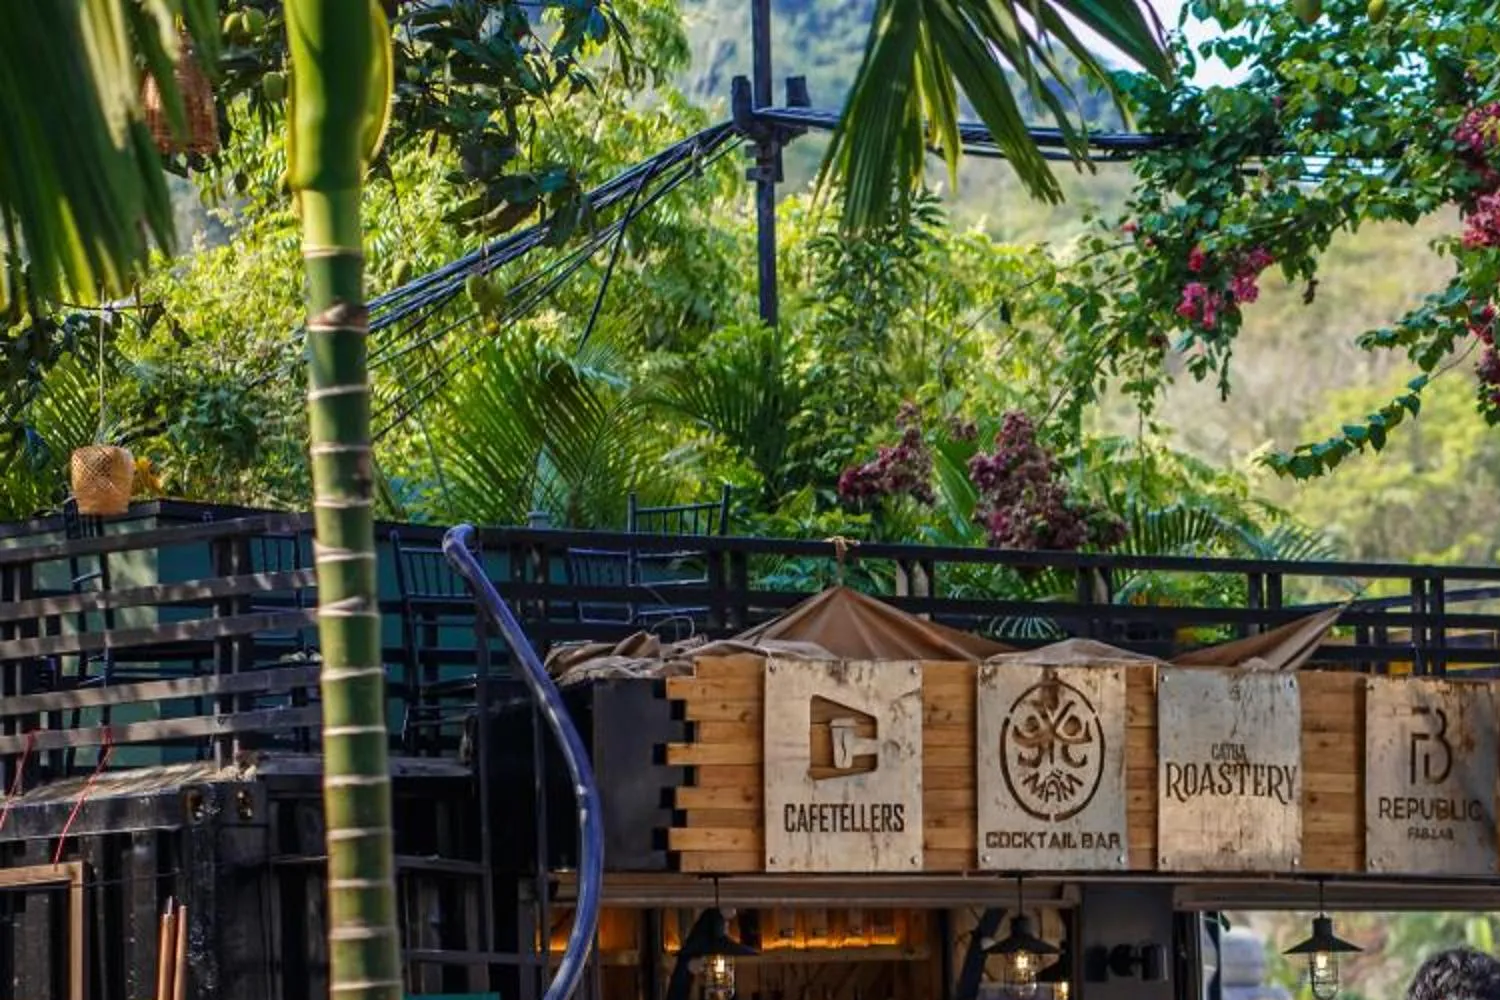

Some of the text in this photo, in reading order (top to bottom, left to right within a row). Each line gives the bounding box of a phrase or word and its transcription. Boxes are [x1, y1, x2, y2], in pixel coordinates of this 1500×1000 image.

[1165, 762, 1298, 805] ROASTERY
[784, 803, 905, 833] CAFETELLERS
[1378, 797, 1483, 821] REPUBLIC
[985, 831, 1121, 850] COCKTAIL BAR
